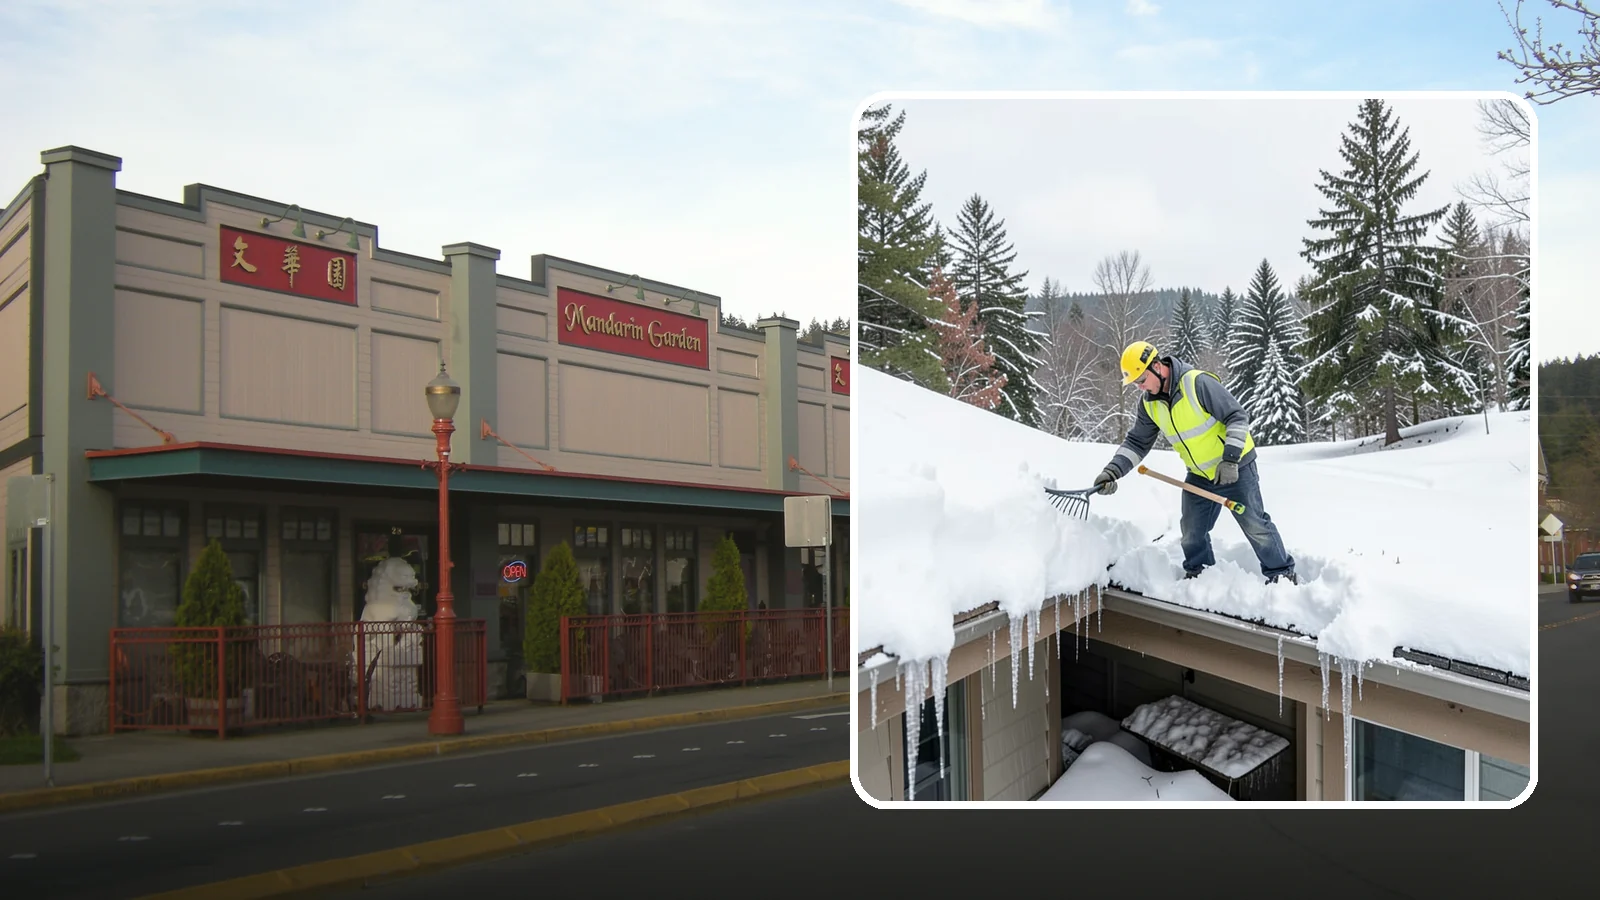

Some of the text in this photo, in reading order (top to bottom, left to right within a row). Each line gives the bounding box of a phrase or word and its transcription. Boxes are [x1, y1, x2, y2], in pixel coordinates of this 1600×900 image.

[230, 235, 346, 291] 文華園
[564, 302, 702, 352] Mandarin Garden
[503, 565, 527, 579] OPEN
